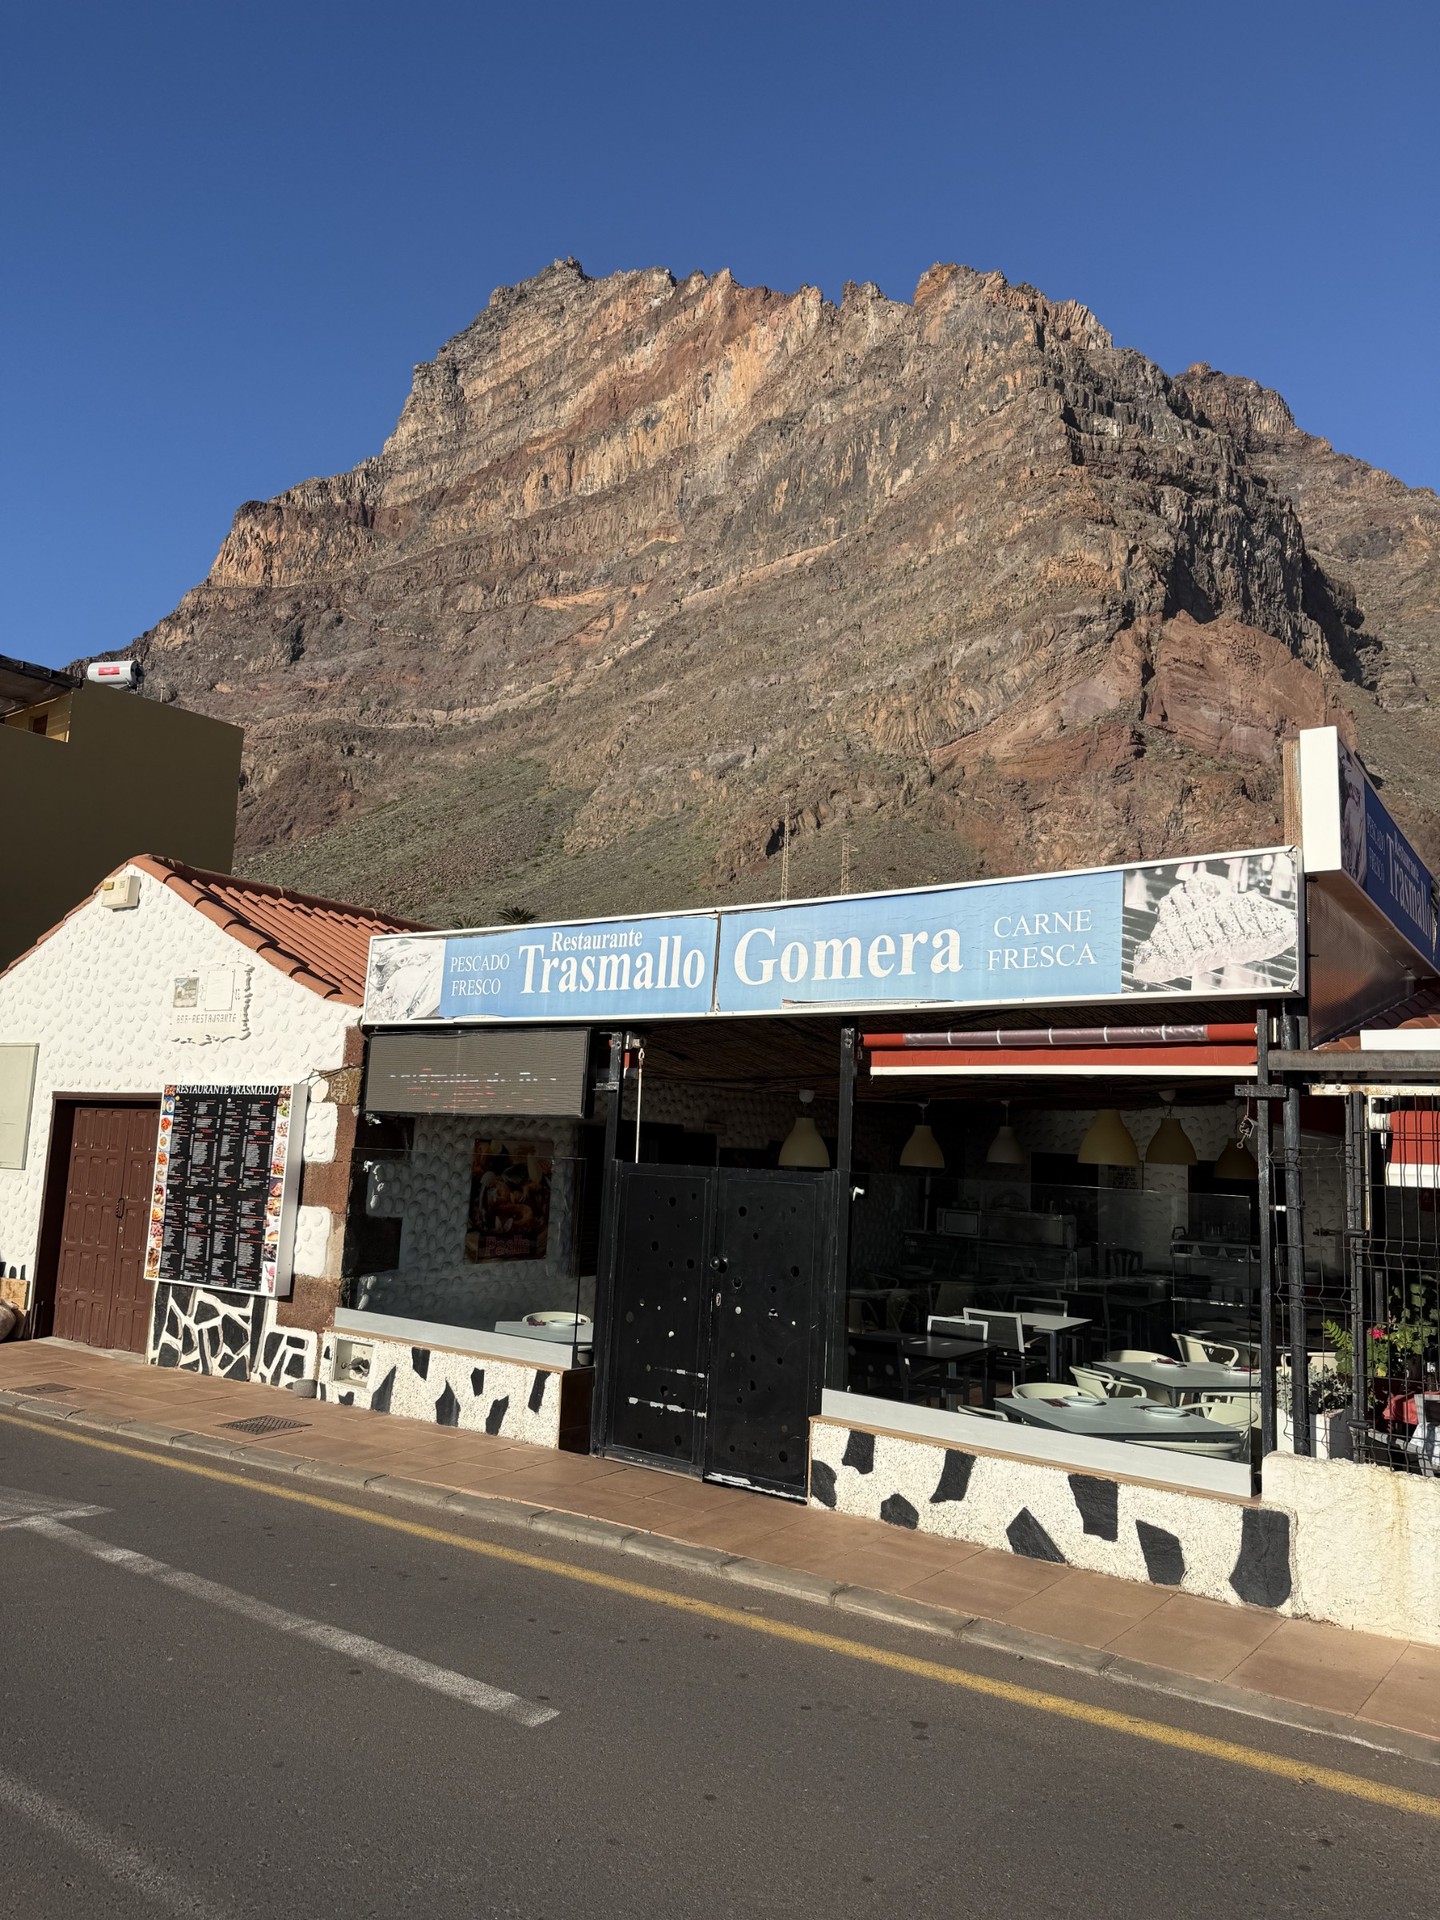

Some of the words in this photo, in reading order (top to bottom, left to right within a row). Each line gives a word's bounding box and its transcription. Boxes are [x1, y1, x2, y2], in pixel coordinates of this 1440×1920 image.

[993, 909, 1092, 939] CARNE
[551, 928, 643, 952] Restaurante
[449, 953, 510, 973] PESCADO
[518, 935, 705, 995] Trasmallo
[734, 926, 963, 986] Gomera
[987, 942, 1098, 972] FRESCA
[451, 978, 501, 997] FRESCO
[175, 1084, 230, 1095] RESTAURANTE
[231, 1085, 279, 1096] TRASMALLO
[484, 1234, 530, 1258] Paella
